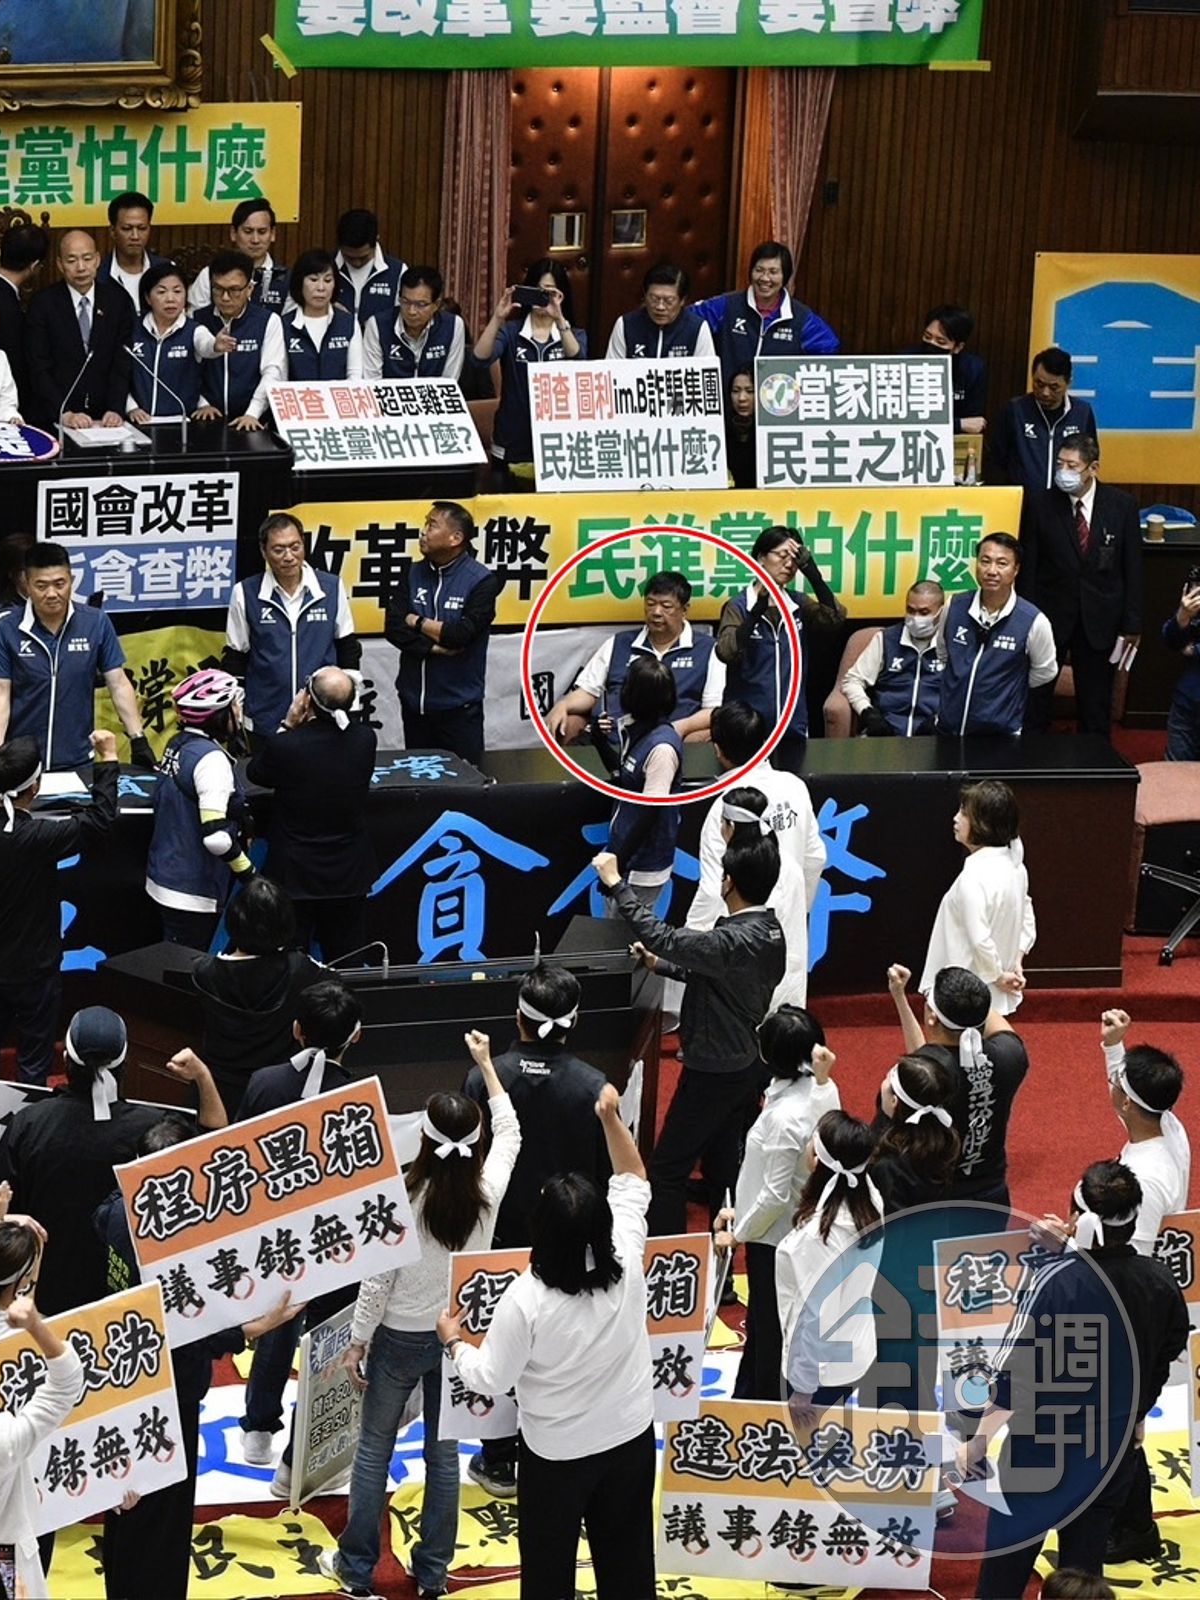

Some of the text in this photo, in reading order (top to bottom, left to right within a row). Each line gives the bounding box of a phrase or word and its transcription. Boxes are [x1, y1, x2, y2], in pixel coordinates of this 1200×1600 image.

[270, 386, 330, 422] 調查
[798, 362, 947, 421] 當家鬧事
[286, 421, 473, 463] 民進黨怕什麼?
[539, 427, 722, 482] 民進黨怕什麼?
[45, 479, 234, 539] 國會改革
[131, 1101, 386, 1240] 程序黑箱
[157, 1193, 403, 1314] 議事錄無效
[34, 1405, 177, 1495] 錄無效
[669, 1414, 928, 1490] 違法表決
[662, 1502, 922, 1560] 議事錄無效
